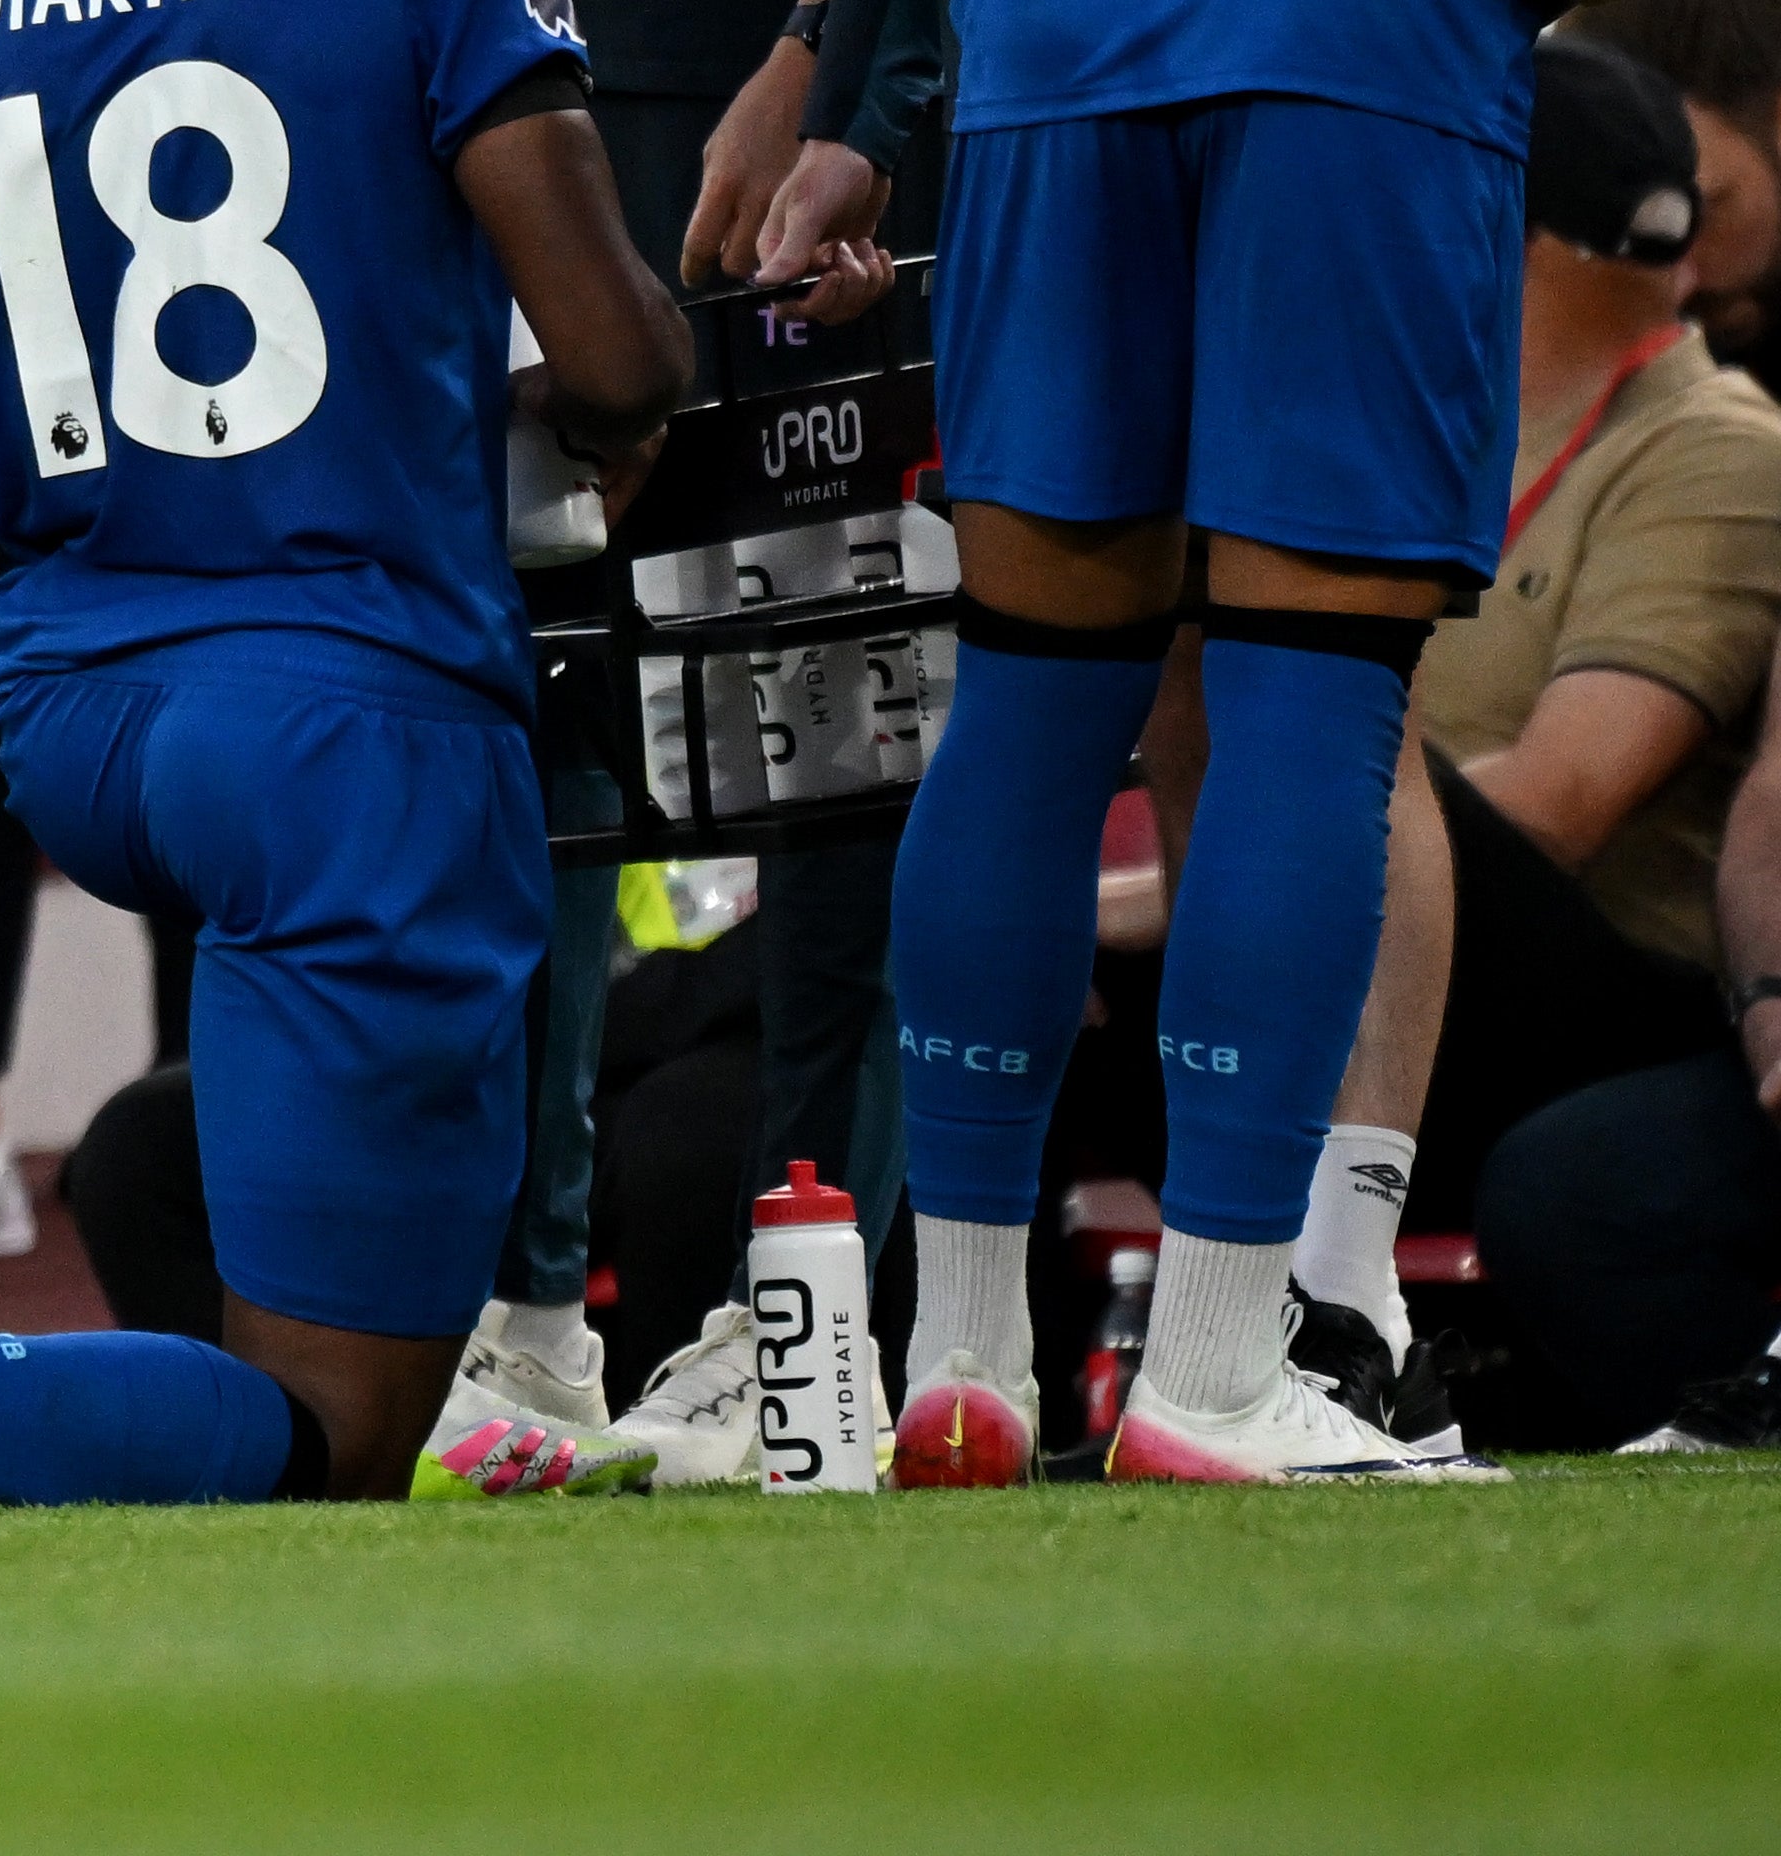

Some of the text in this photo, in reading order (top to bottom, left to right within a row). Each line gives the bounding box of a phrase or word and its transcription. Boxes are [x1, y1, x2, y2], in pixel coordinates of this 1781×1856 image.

[783, 479, 849, 508] HYDRATE
[898, 1025, 1030, 1075] AFCB
[833, 1310, 857, 1444] HYDRATE
